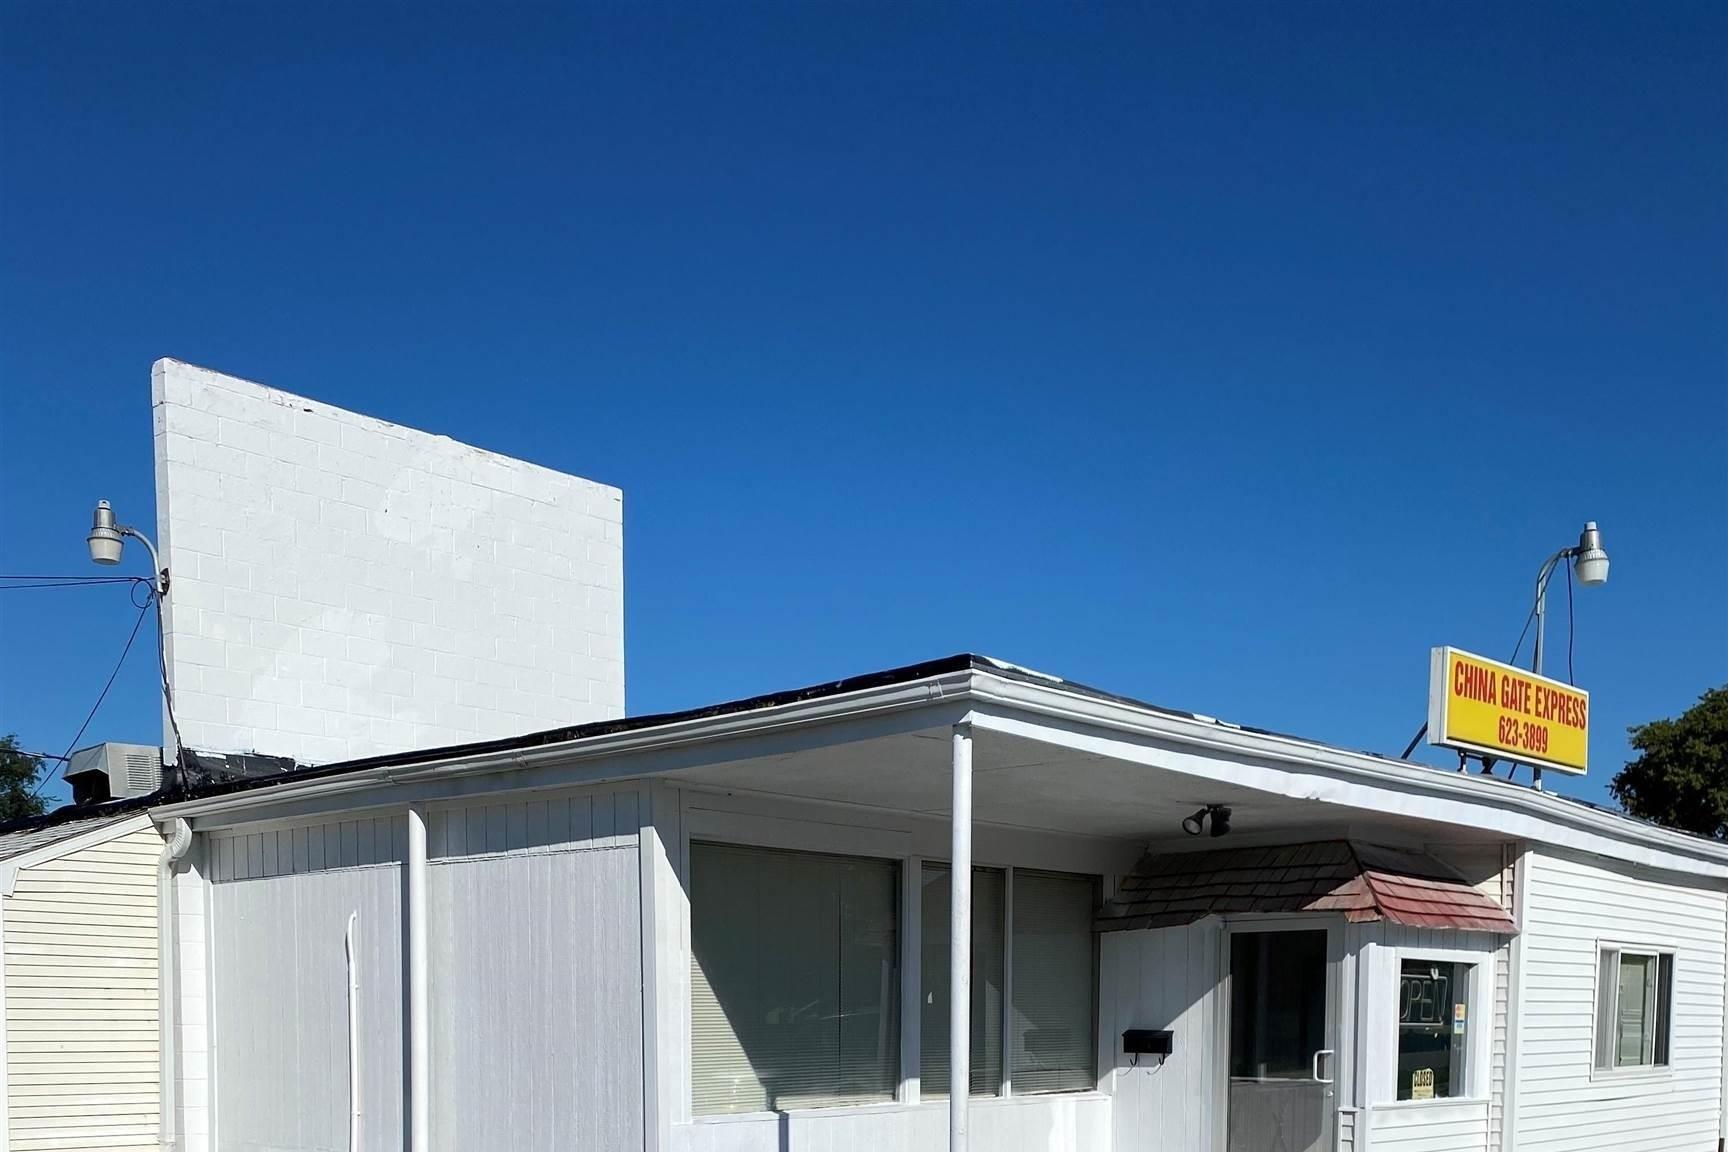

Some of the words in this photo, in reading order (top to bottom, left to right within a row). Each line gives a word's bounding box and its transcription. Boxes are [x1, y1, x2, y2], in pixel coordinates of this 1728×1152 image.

[1454, 661, 1497, 705] CHINA
[1501, 675, 1532, 714] GATE
[1535, 685, 1587, 730] EXPRESS
[1498, 716, 1549, 753] 623-3899
[1400, 980, 1446, 1021] OPEN
[1413, 1071, 1433, 1087] CLOSED
